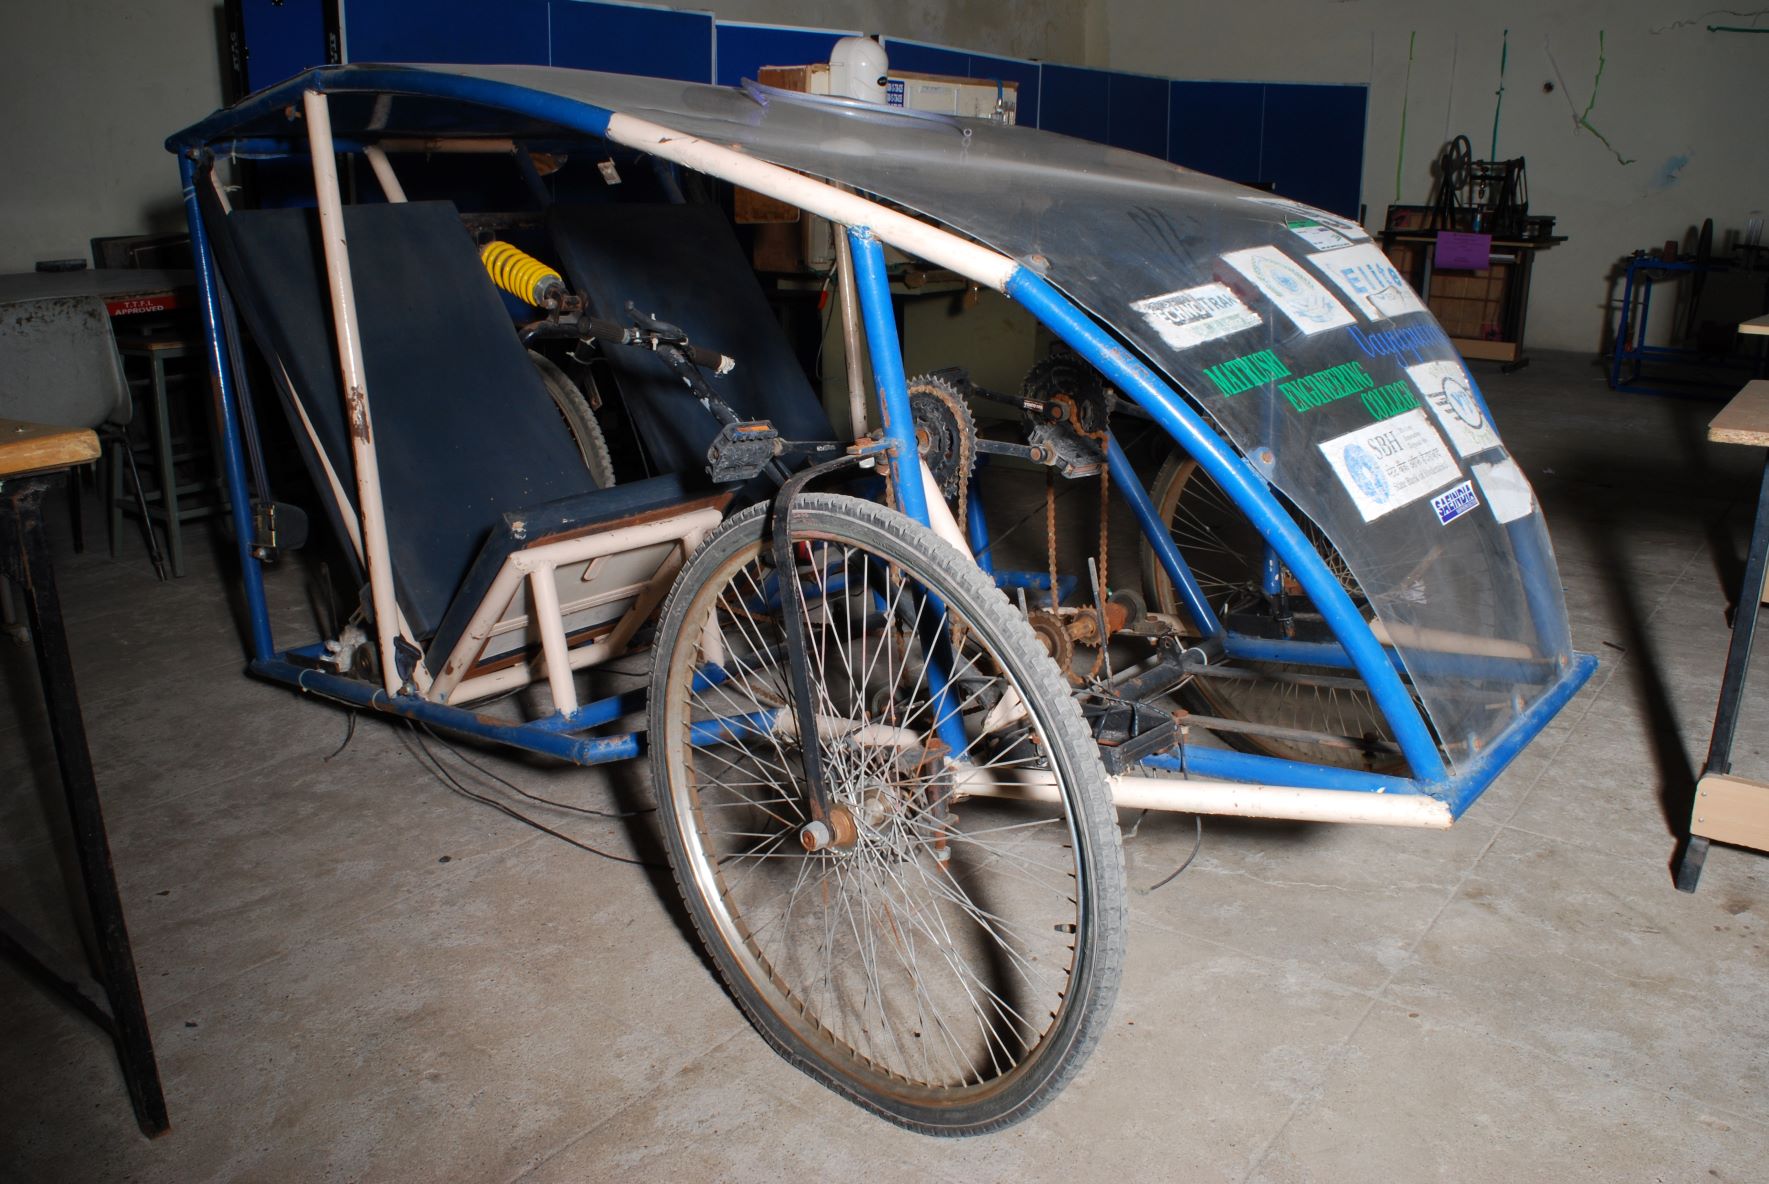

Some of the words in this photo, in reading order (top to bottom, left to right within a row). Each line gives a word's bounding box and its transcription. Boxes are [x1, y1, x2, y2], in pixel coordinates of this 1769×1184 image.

[115, 305, 165, 316] APPROVED
[1278, 361, 1374, 413] ENGINEERING
[1360, 379, 1421, 421] COLLEGE
[1368, 430, 1403, 460] SBH
[1434, 483, 1475, 516] SAEINDIA
